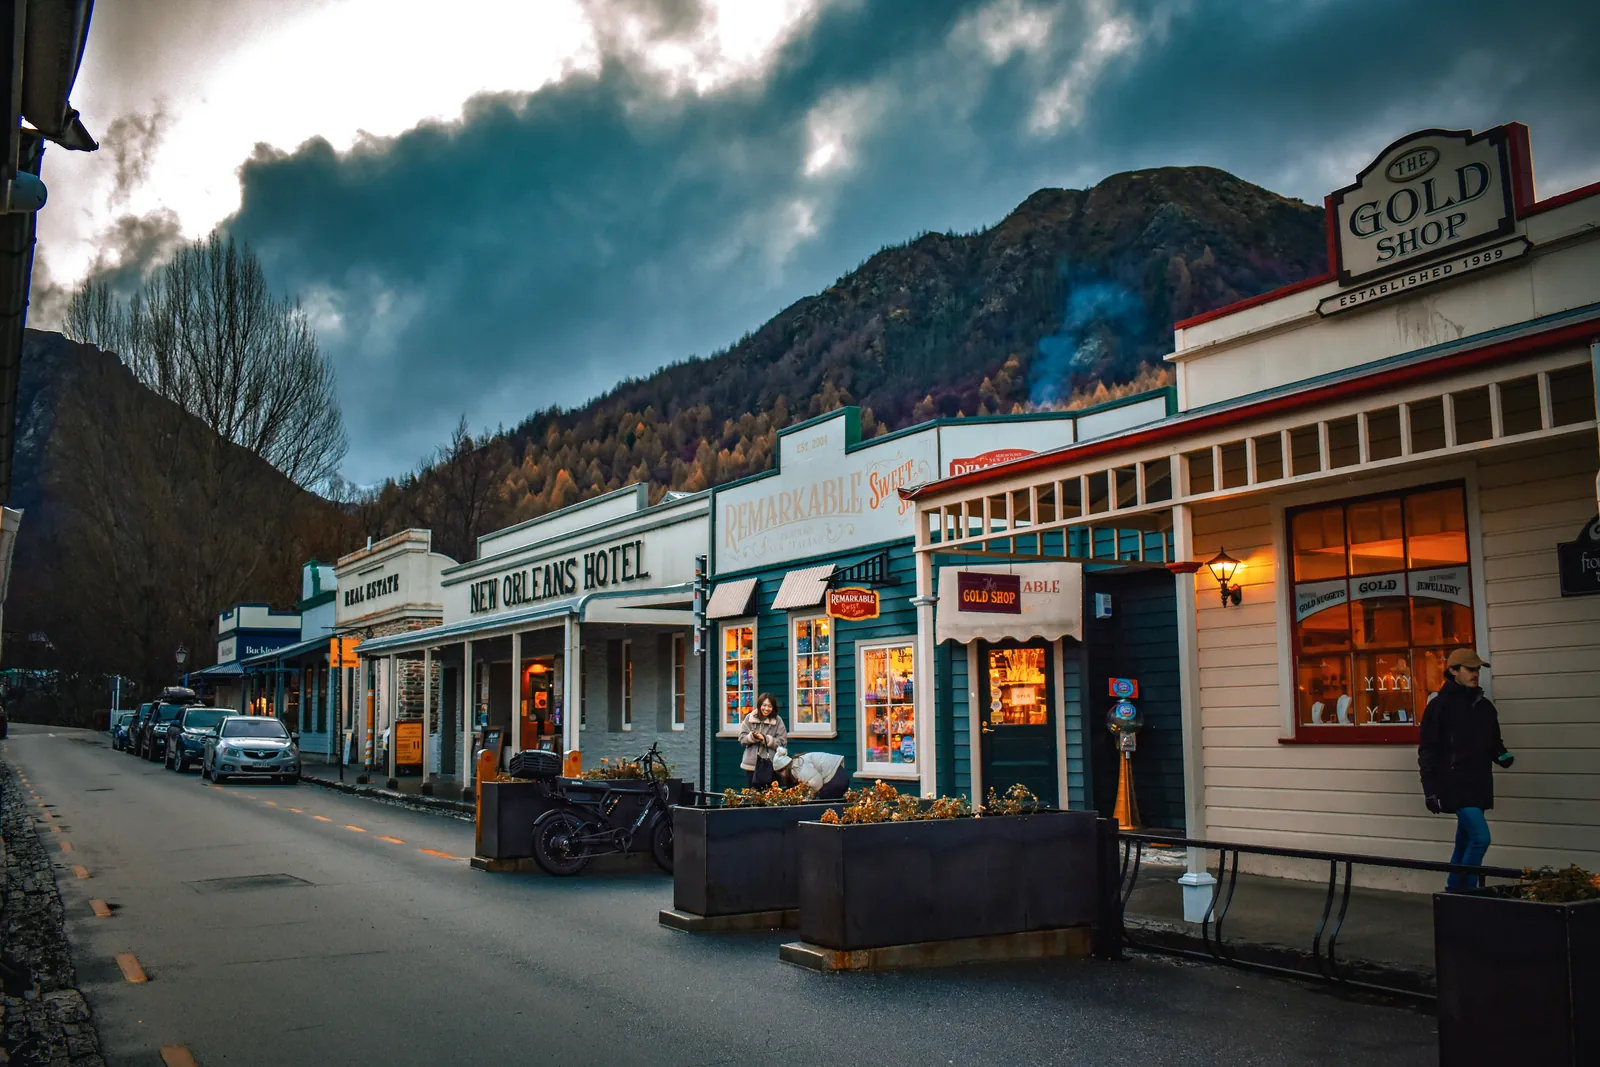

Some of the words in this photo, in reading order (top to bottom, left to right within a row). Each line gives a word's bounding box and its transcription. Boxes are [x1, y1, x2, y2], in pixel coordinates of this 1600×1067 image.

[1395, 152, 1429, 176] THE
[1349, 161, 1492, 239] GOLD
[1376, 212, 1467, 263] SHOP
[1340, 264, 1453, 307] ESTABLISHED
[1463, 249, 1503, 270] 1989
[869, 459, 914, 510] SWEET
[724, 471, 863, 553] REMARKABLE
[344, 585, 365, 607] REAL
[366, 573, 399, 600] ESTATE
[470, 578, 498, 614] NEW
[502, 557, 576, 607] ORLEANS
[583, 540, 650, 591] HOTEL
[1359, 579, 1397, 594] GOLD
[1416, 581, 1462, 596] JEWELLERY
[831, 593, 875, 605] REMARKABLE
[963, 589, 989, 603] GOLD
[991, 591, 1016, 604] SHOP
[1299, 599, 1315, 613] GOLD
[1316, 589, 1345, 605] NUGGETS
